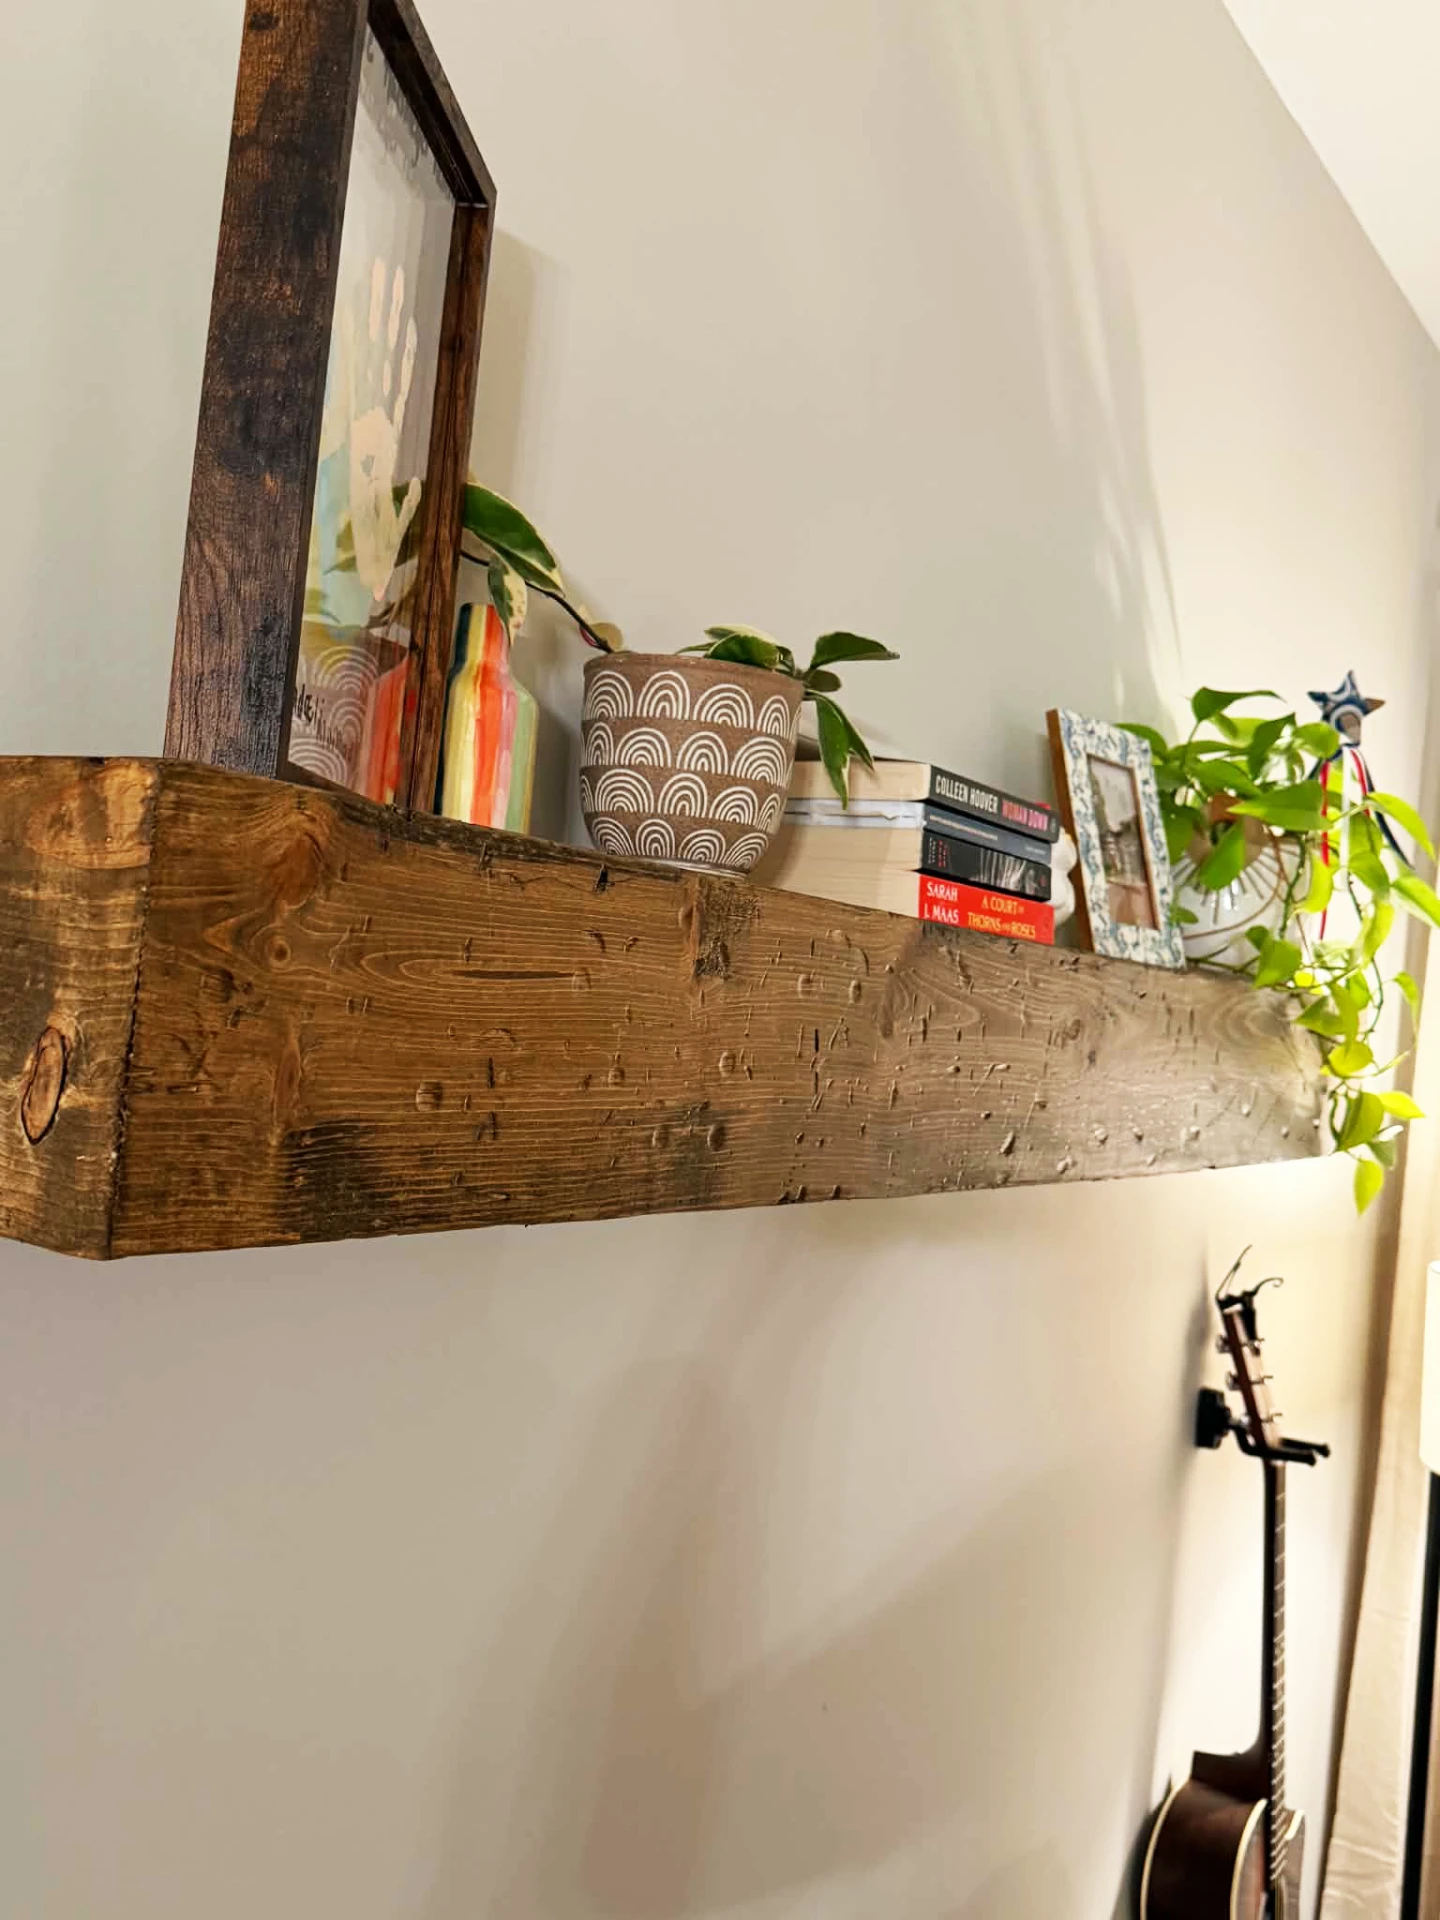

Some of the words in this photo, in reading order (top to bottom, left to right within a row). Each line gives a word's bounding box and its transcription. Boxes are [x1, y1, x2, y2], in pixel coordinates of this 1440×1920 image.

[936, 775, 967, 802] COLLEEN
[970, 787, 998, 813] HOOVER
[926, 881, 958, 901] SARAH
[932, 904, 959, 924] MAAS
[981, 896, 989, 909] A
[990, 898, 1018, 915] COURT
[968, 912, 1001, 931] THORNS
[1011, 922, 1036, 939] ROSES
